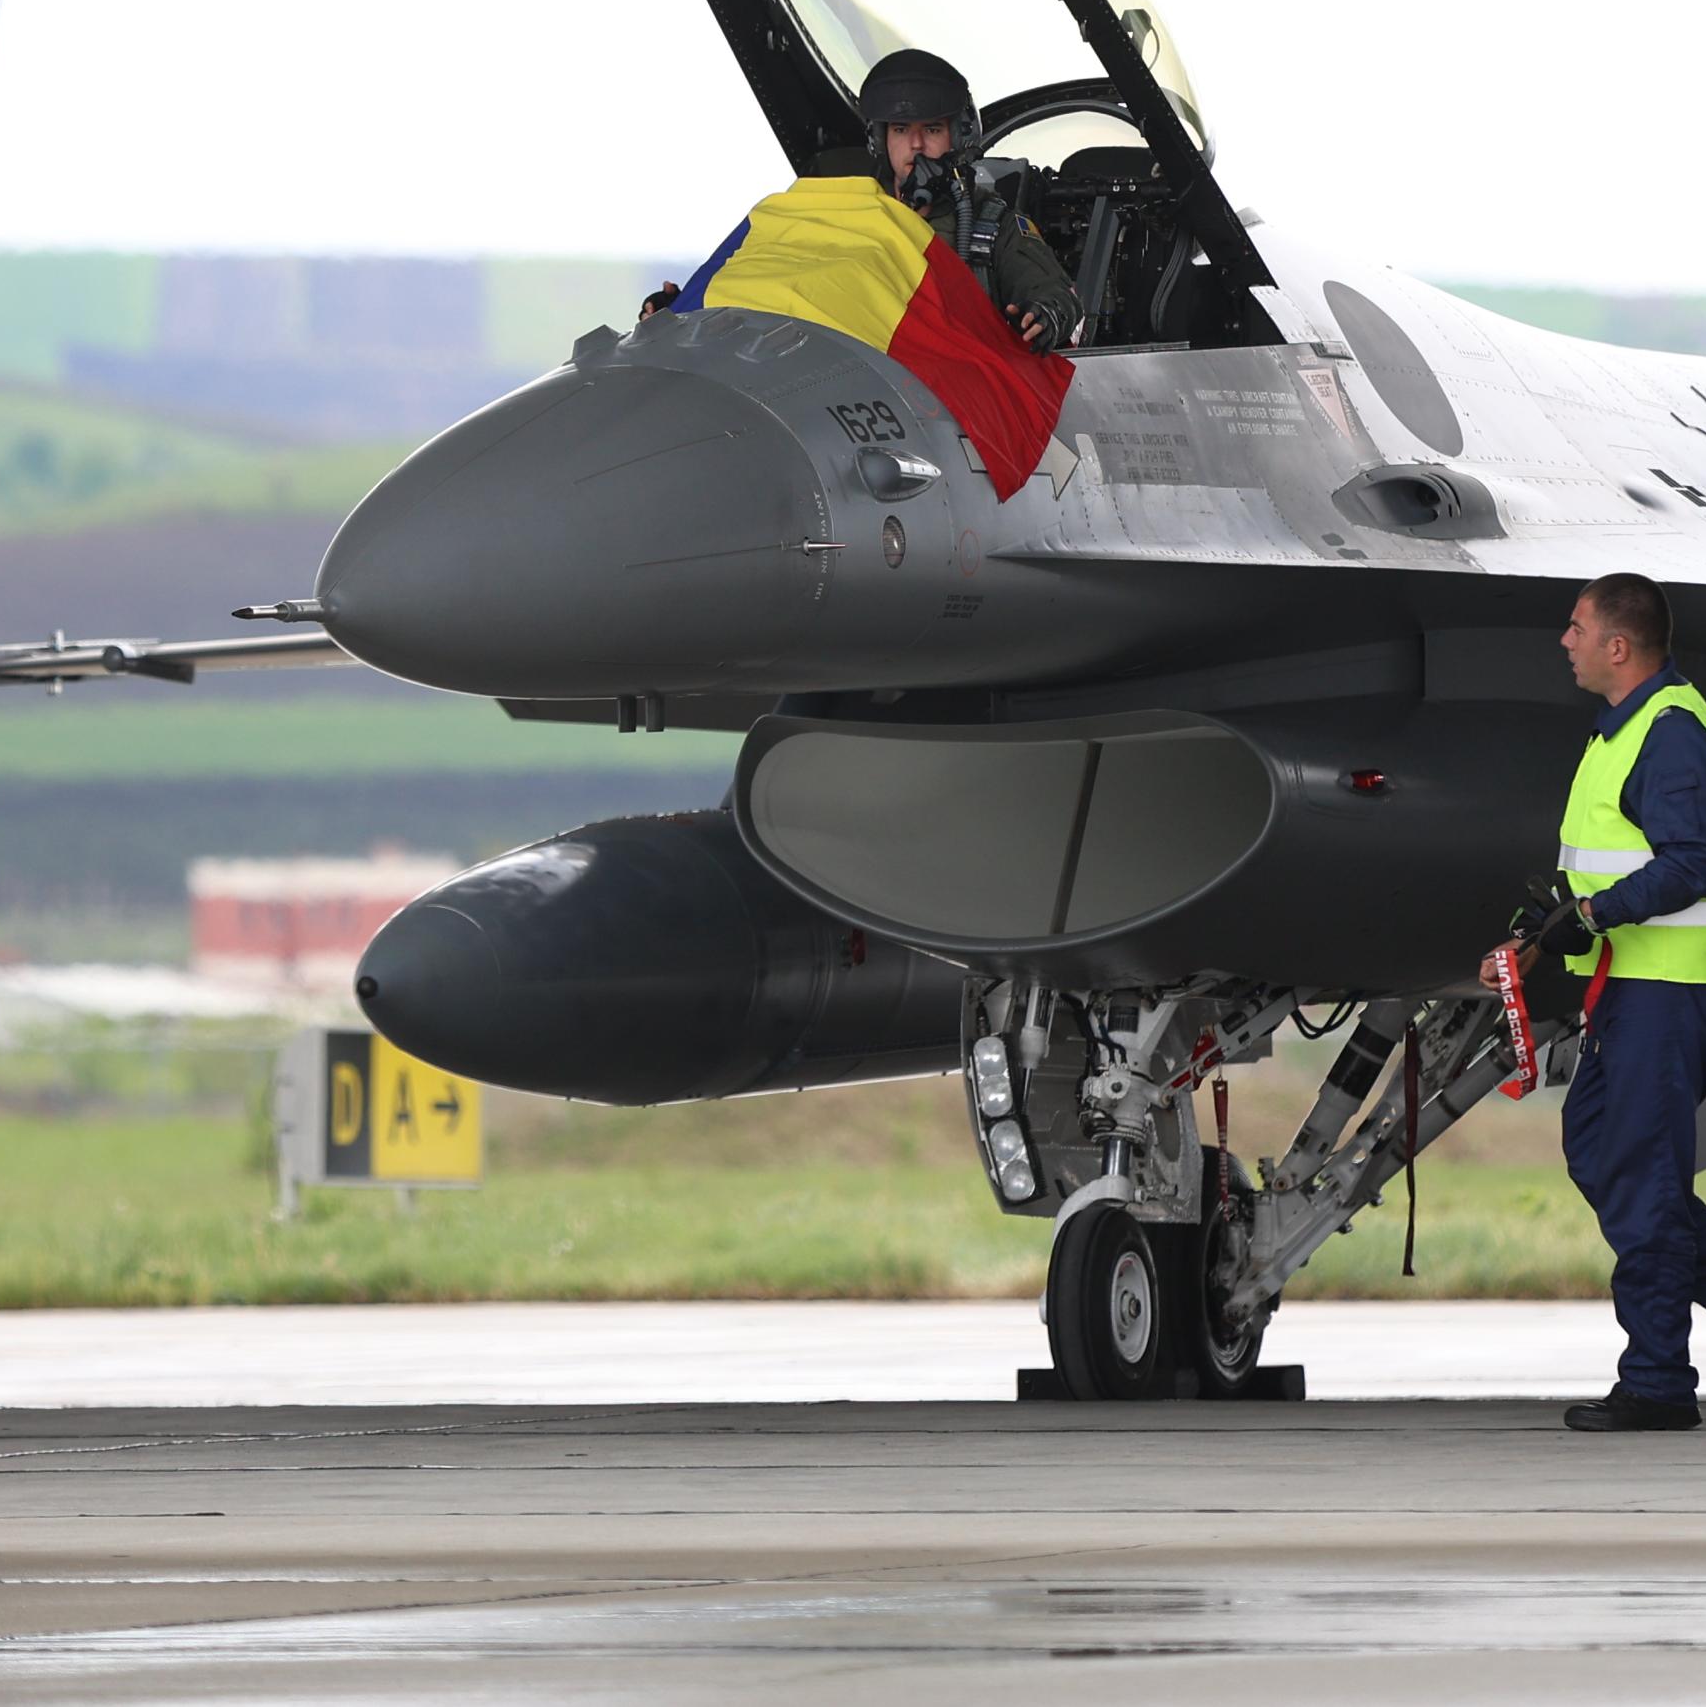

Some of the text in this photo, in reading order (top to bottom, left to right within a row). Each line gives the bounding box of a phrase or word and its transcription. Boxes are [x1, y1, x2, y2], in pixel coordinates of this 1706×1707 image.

[826, 400, 905, 443] 1629
[1495, 950, 1516, 1005] EMOVE
[332, 1061, 421, 1146] D A
